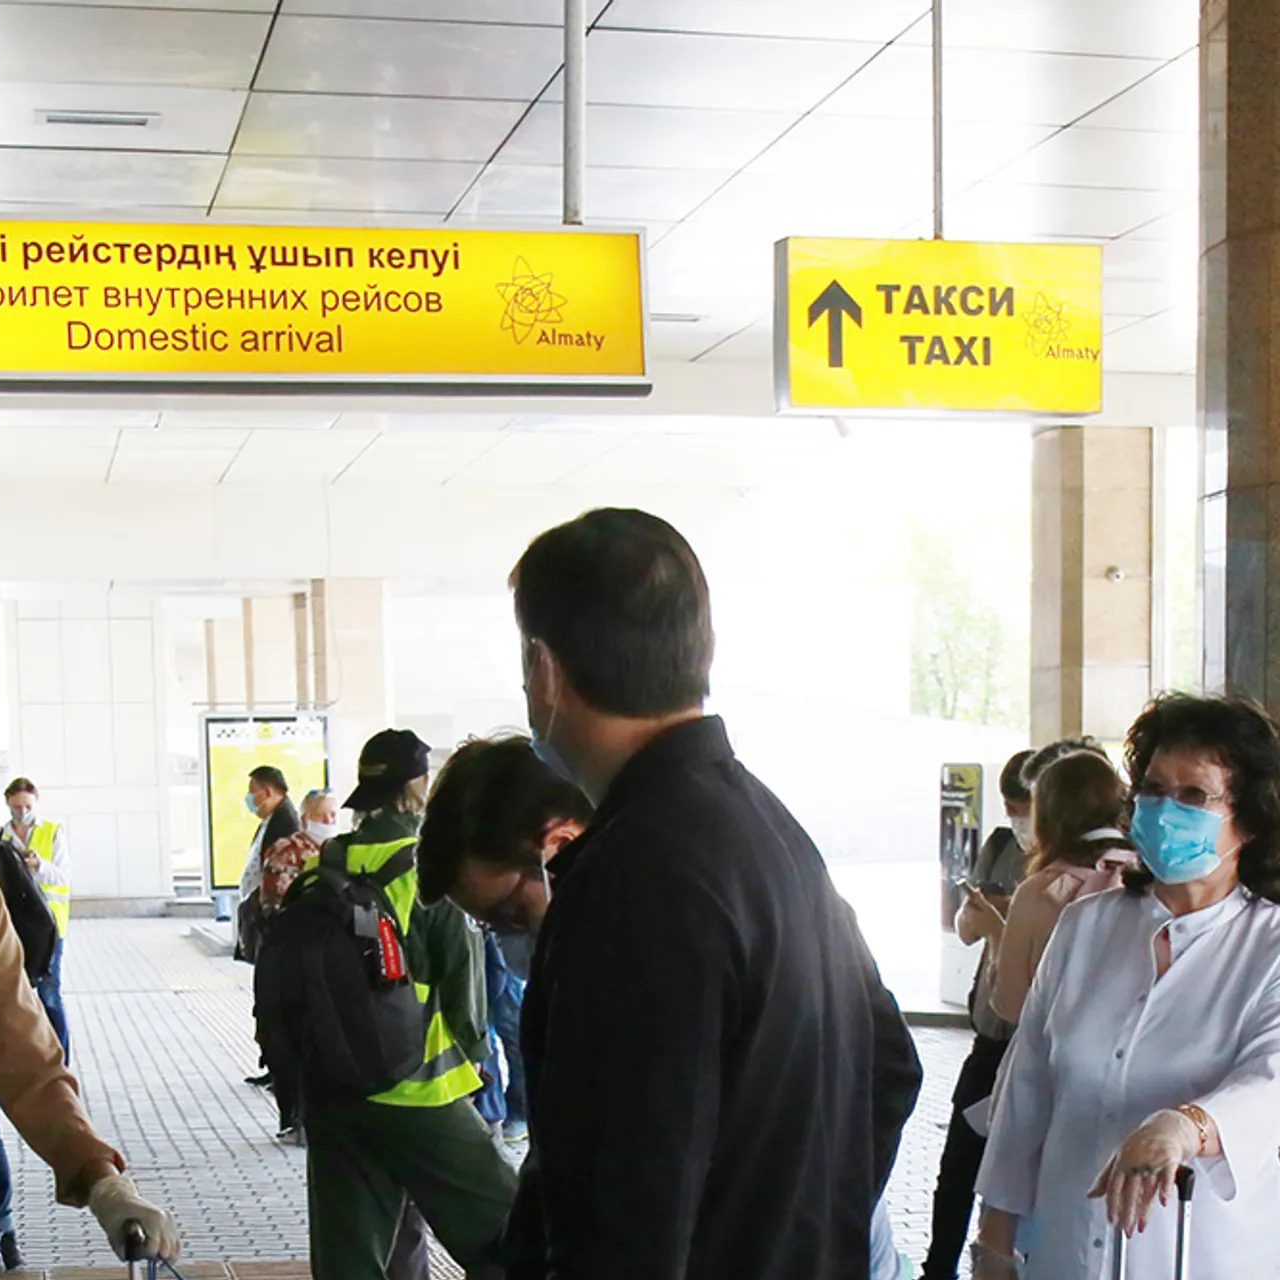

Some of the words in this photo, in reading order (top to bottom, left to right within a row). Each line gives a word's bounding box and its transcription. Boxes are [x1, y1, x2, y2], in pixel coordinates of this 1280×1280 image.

[368, 241, 460, 278] келуі
[103, 285, 309, 317] внутренних
[321, 283, 443, 318] рейсов
[876, 284, 1014, 317] ТАКСИ
[67, 320, 229, 352] Domestic
[240, 323, 344, 353] arrival
[536, 328, 605, 352] Almaty
[899, 335, 992, 366] TAXI
[1044, 344, 1101, 362] Almaty
